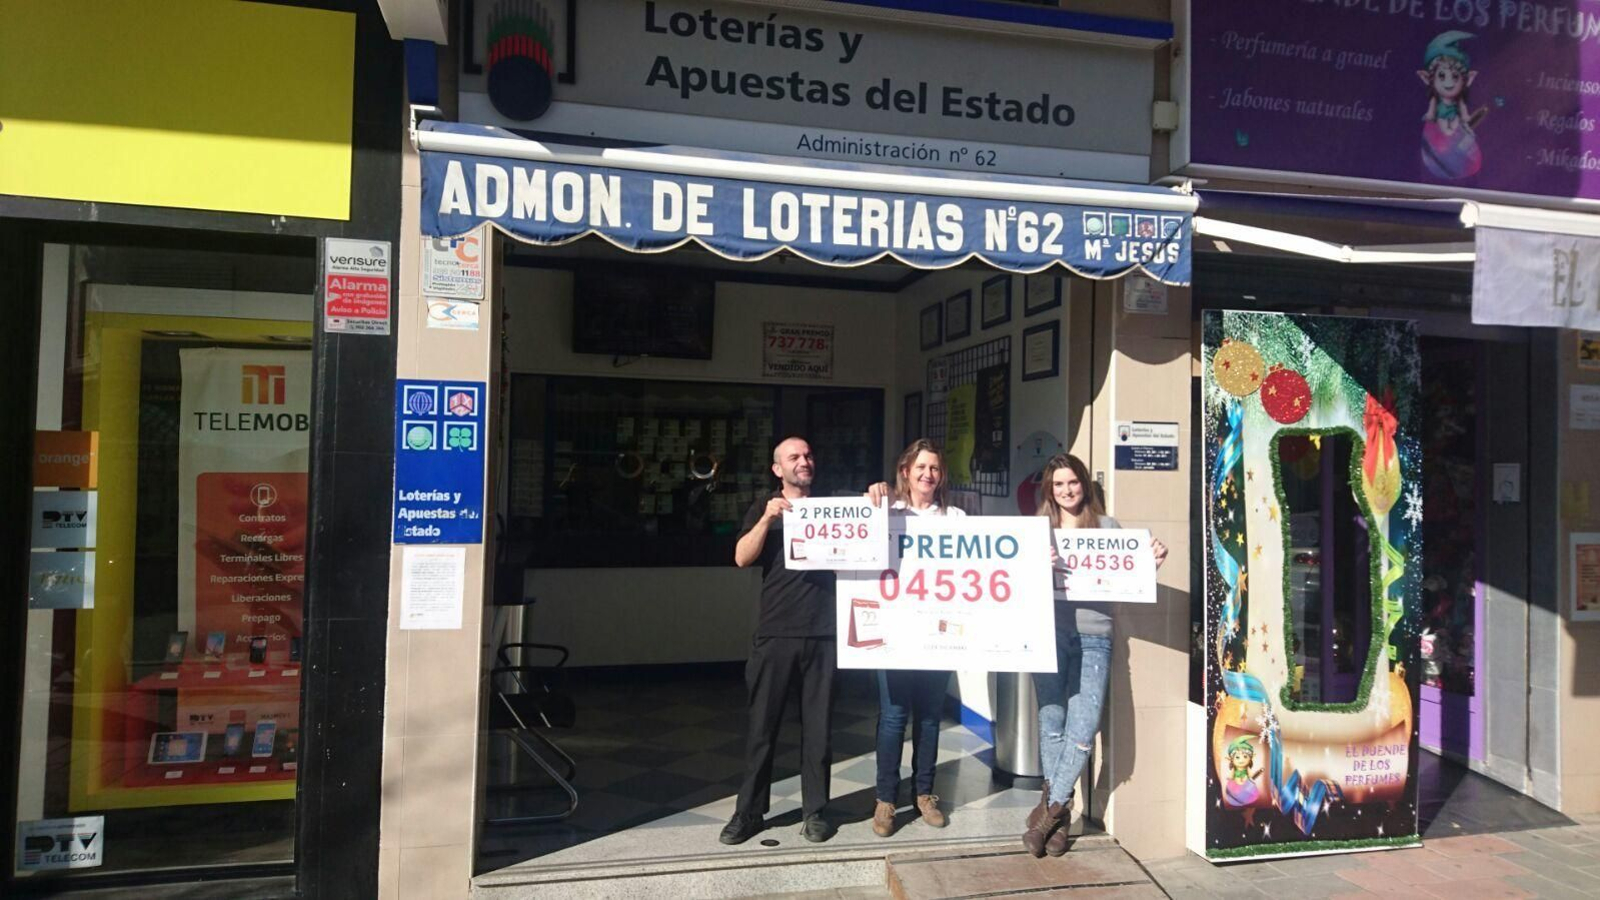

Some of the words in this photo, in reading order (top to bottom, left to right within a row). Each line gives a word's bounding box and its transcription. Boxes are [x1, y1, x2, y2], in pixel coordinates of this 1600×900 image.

[644, 1, 824, 52] Loterías
[838, 31, 864, 63] y
[1221, 30, 1318, 60] Perfumería
[1322, 49, 1333, 62] a
[1335, 50, 1393, 71] granel
[645, 55, 850, 107] Apuestas
[865, 78, 927, 115] del
[941, 86, 1076, 127] Estado
[1219, 87, 1291, 112] Jabones
[1295, 100, 1374, 121] naturales
[1537, 109, 1596, 134] Regalos
[797, 133, 940, 162] Administración
[950, 147, 969, 164] nº
[974, 149, 997, 167] 62
[439, 160, 632, 229] ADMON.
[653, 179, 714, 236] DE
[743, 187, 964, 252] LOTERIAS
[1114, 240, 1181, 264] JESUS
[329, 255, 387, 267] verisure
[1553, 239, 1586, 307] EL
[329, 277, 387, 292] Alarma
[330, 305, 353, 314] Aviso
[768, 362, 806, 372] VENDIDO
[39, 452, 89, 467] orange
[398, 489, 451, 502] Loterías
[453, 492, 462, 505] y
[238, 512, 287, 523] Contratos
[397, 507, 457, 522] Apuestas
[799, 507, 808, 519] 2
[813, 506, 873, 519] PREMIO
[398, 525, 441, 537] stado
[804, 523, 869, 540] 04536
[240, 533, 284, 545] Recargas
[897, 533, 1020, 560] PREMIO
[1062, 538, 1071, 549] 2
[1076, 538, 1139, 550] PREMIO
[220, 553, 274, 564] Terminales
[274, 552, 304, 563] Libres
[1067, 554, 1135, 571] 04536
[210, 572, 274, 585] Reparaciones
[879, 568, 1012, 603] 04536
[231, 592, 292, 603] Liberaciones
[241, 612, 281, 624] Prepago
[1345, 746, 1358, 758] EL
[1361, 744, 1406, 757] DUENDE
[1353, 760, 1367, 772] DE
[1370, 759, 1391, 771] LOS
[1345, 772, 1401, 786] PERFUMES
[45, 852, 97, 864] TELECOM
